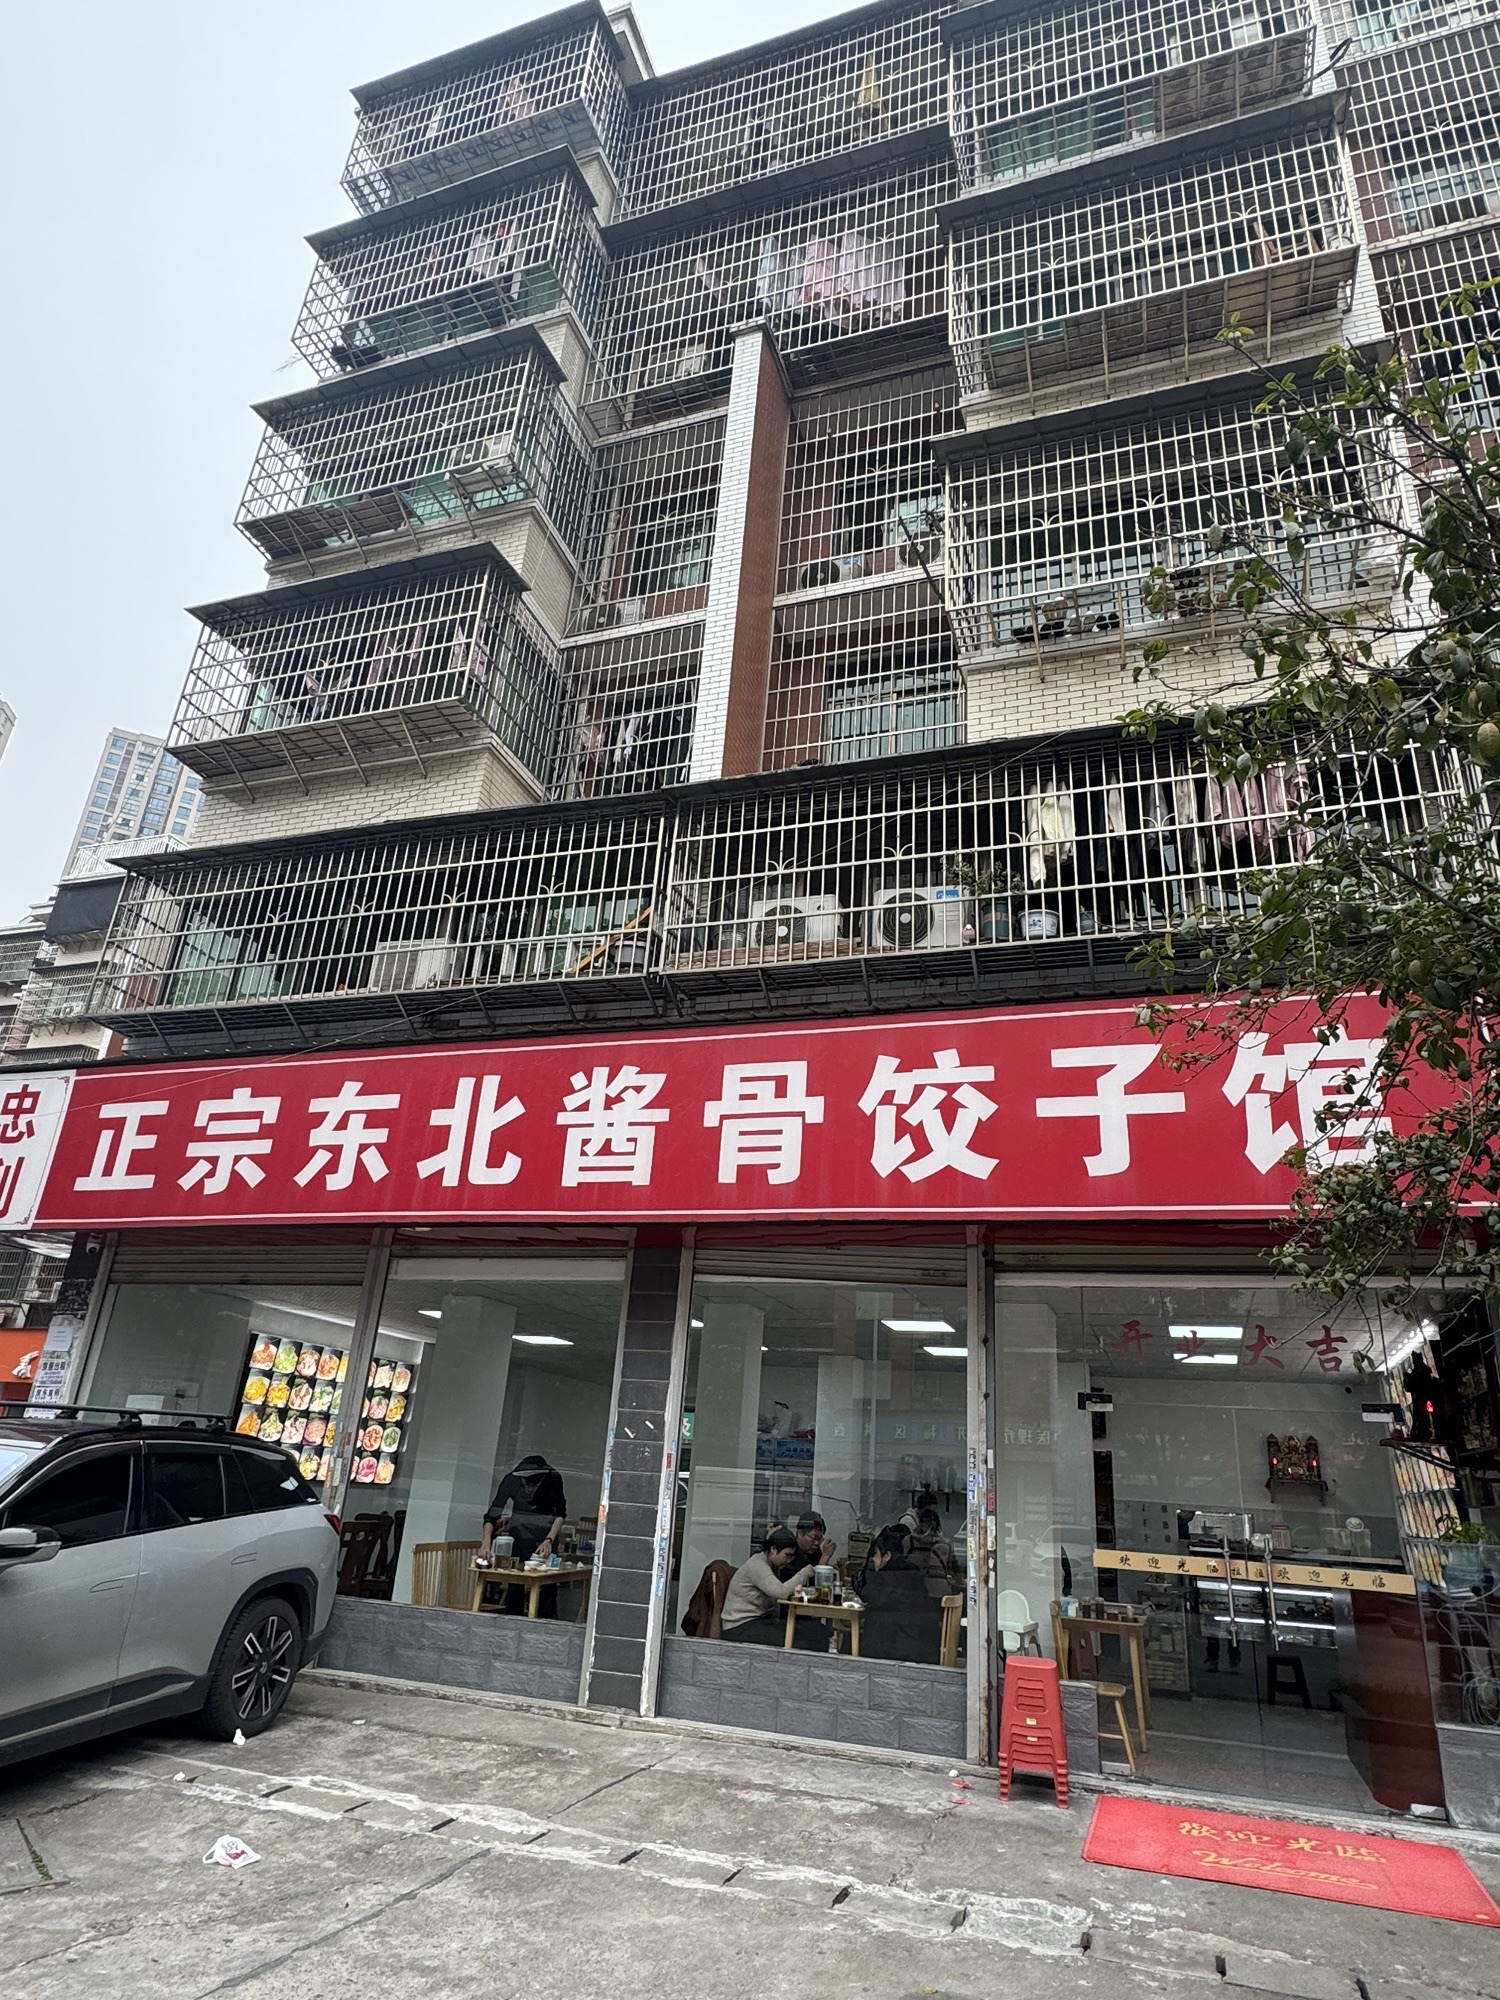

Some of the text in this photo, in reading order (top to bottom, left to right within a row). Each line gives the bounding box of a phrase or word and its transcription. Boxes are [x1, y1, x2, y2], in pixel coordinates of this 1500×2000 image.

[74, 1023, 1393, 1195] 正宗东北酱骨饺子馆
[1112, 1319, 1348, 1373] 开业大吉
[1119, 1554, 1219, 1574] 欢迎光临
[1277, 1567, 1386, 1588] 欢迎光临
[1193, 1851, 1370, 1887] Welcome
